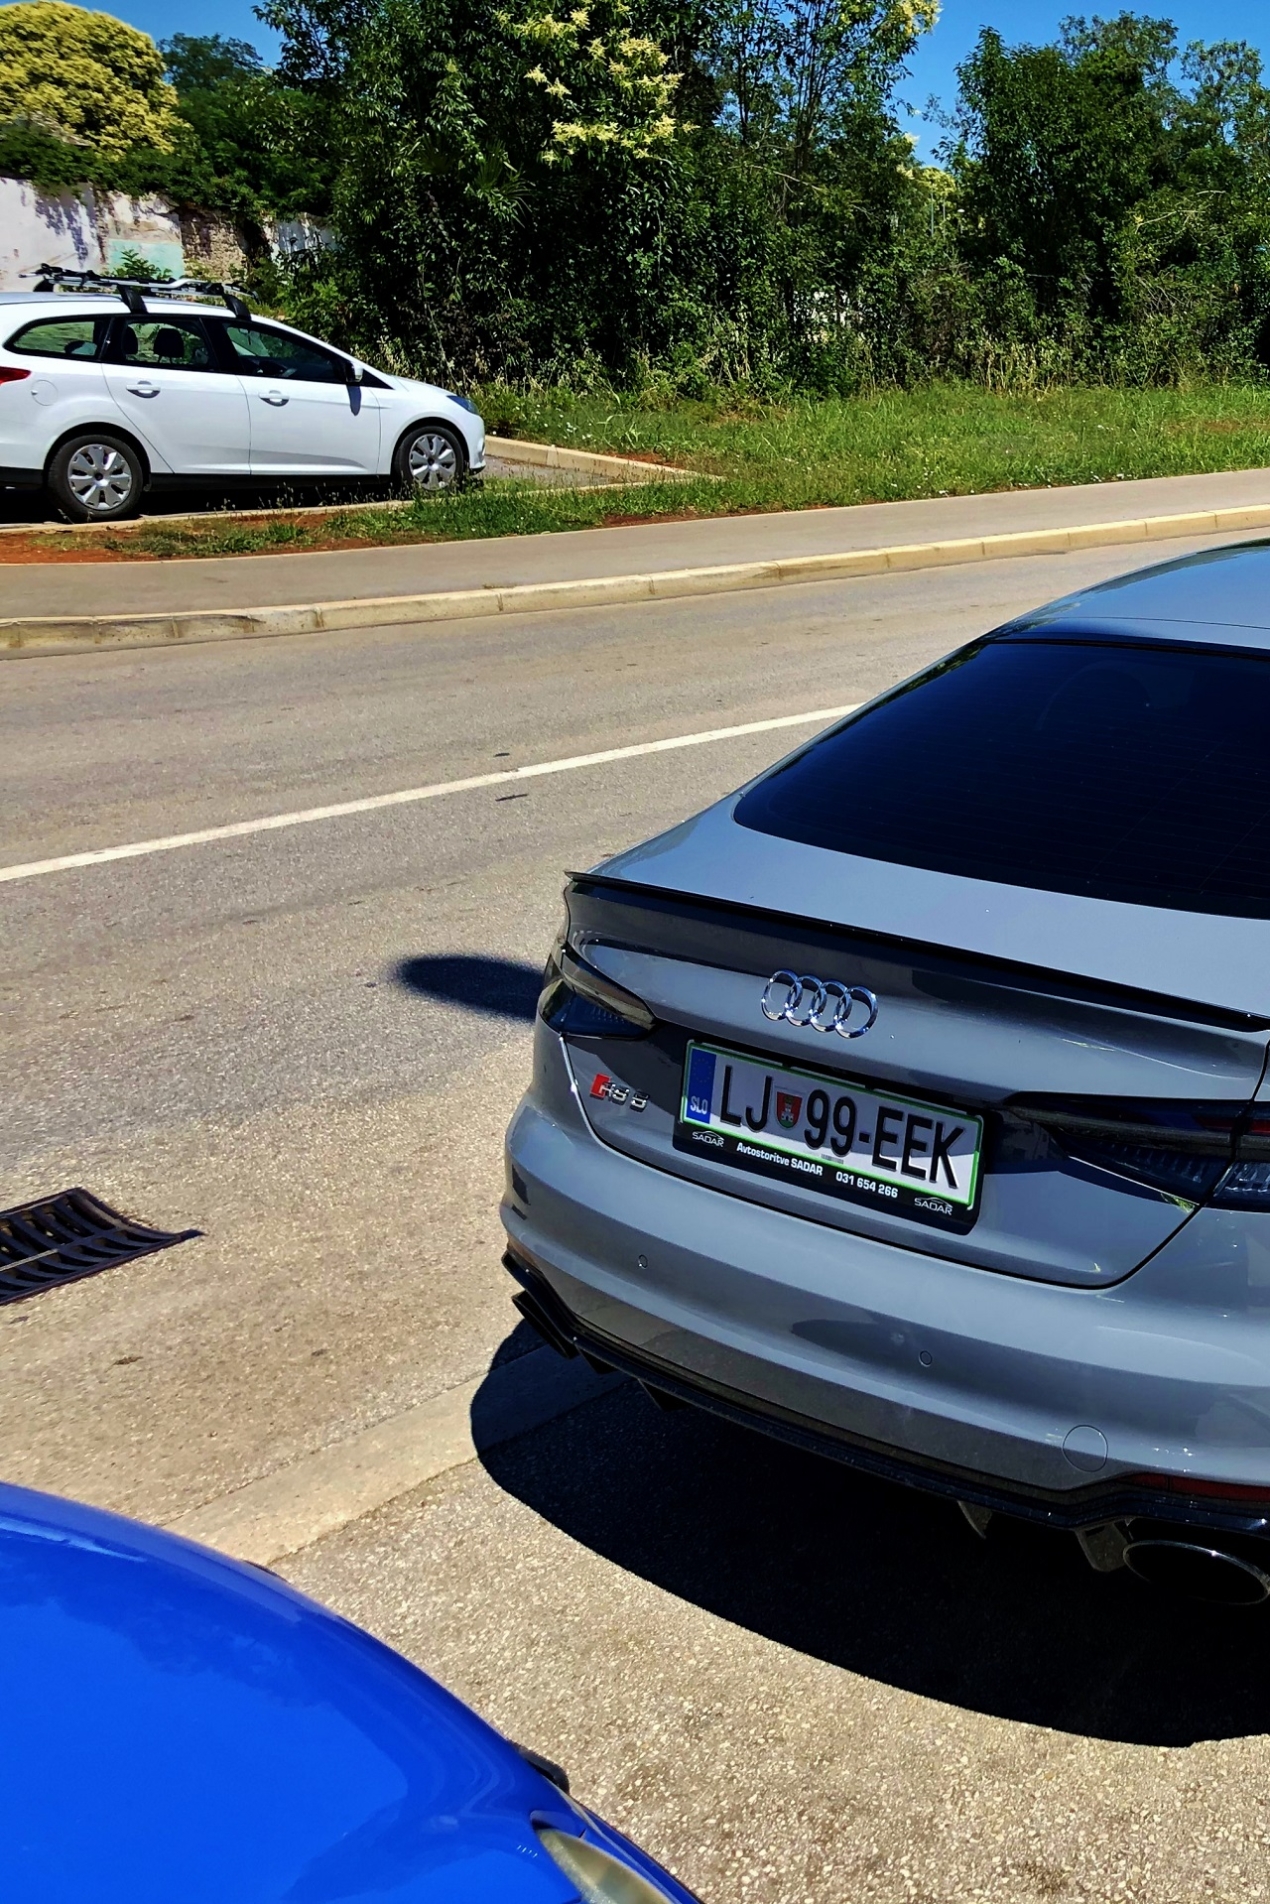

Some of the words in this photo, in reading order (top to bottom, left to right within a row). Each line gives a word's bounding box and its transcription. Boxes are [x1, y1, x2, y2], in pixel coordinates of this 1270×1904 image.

[690, 1095, 708, 1115] SLO
[720, 1065, 773, 1132] LJ
[804, 1089, 965, 1190] 99-EEK
[692, 1131, 725, 1148] SADAR
[737, 1142, 790, 1167] Avtostoritve
[791, 1158, 823, 1176] SADAR
[835, 1171, 855, 1186] 031
[857, 1178, 877, 1193] 654
[878, 1184, 899, 1198] 266
[914, 1198, 953, 1216] SADAR
